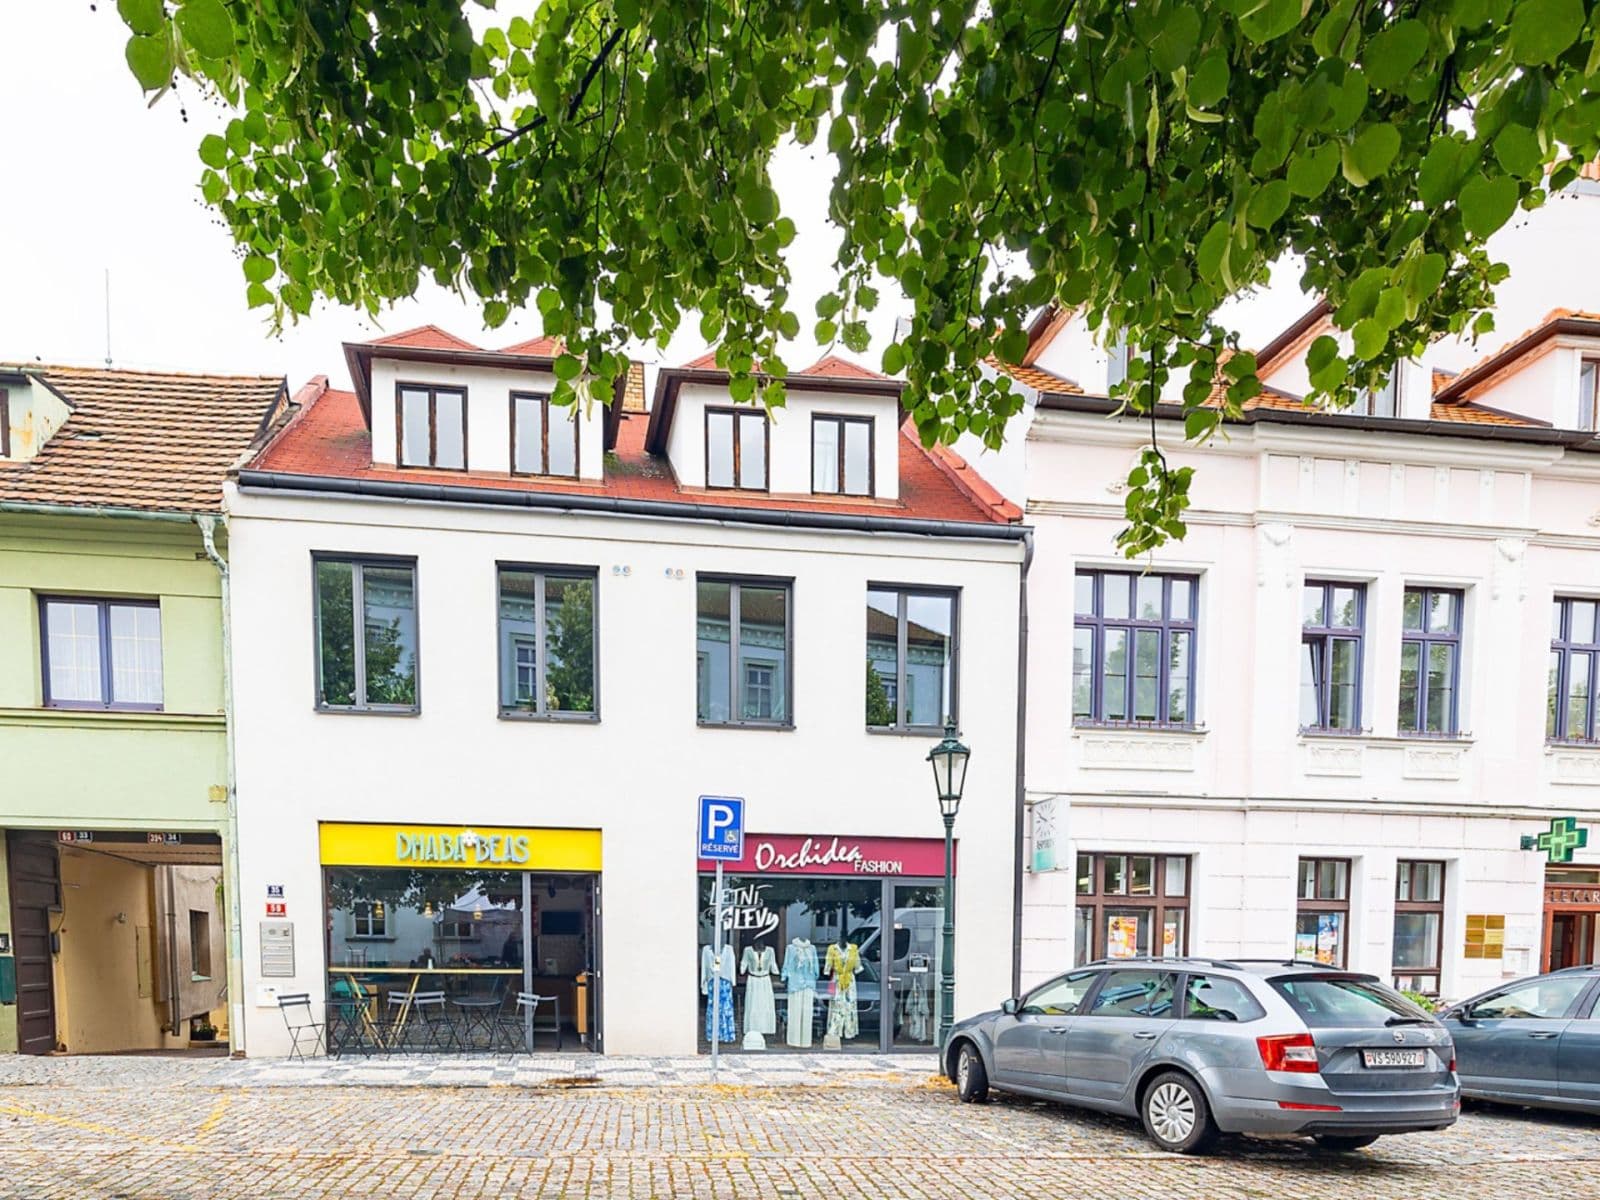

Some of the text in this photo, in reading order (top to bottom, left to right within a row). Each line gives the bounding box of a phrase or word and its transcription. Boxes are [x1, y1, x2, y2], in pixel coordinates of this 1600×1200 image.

[708, 804, 734, 840] P
[396, 832, 530, 864] DHABA BEAS
[755, 837, 864, 870] Orchidea
[853, 859, 903, 873] FASHION
